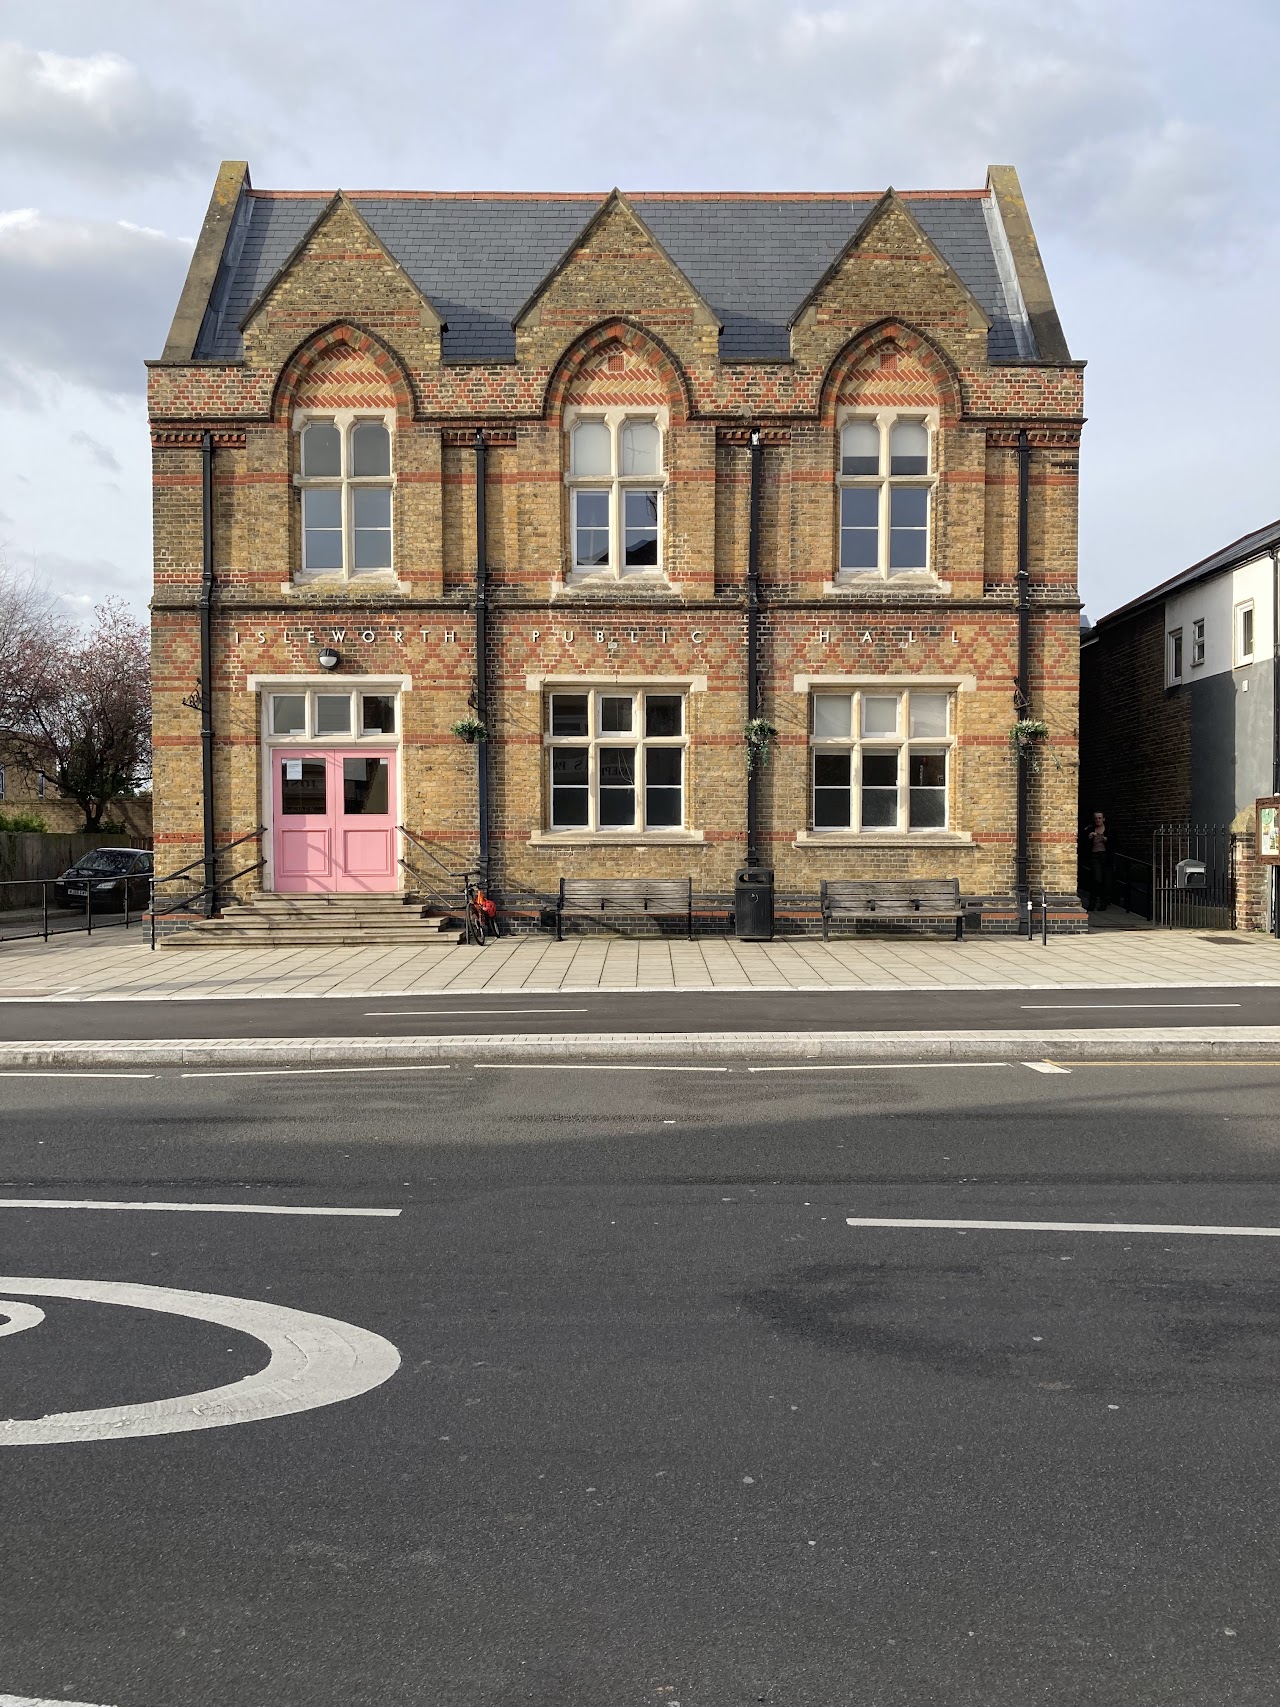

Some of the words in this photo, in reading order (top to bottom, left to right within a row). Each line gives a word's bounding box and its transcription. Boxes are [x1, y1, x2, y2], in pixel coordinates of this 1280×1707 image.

[235, 630, 456, 644] ISLEWORTH
[533, 630, 702, 643] PUBLIC
[819, 630, 959, 643] HALL
